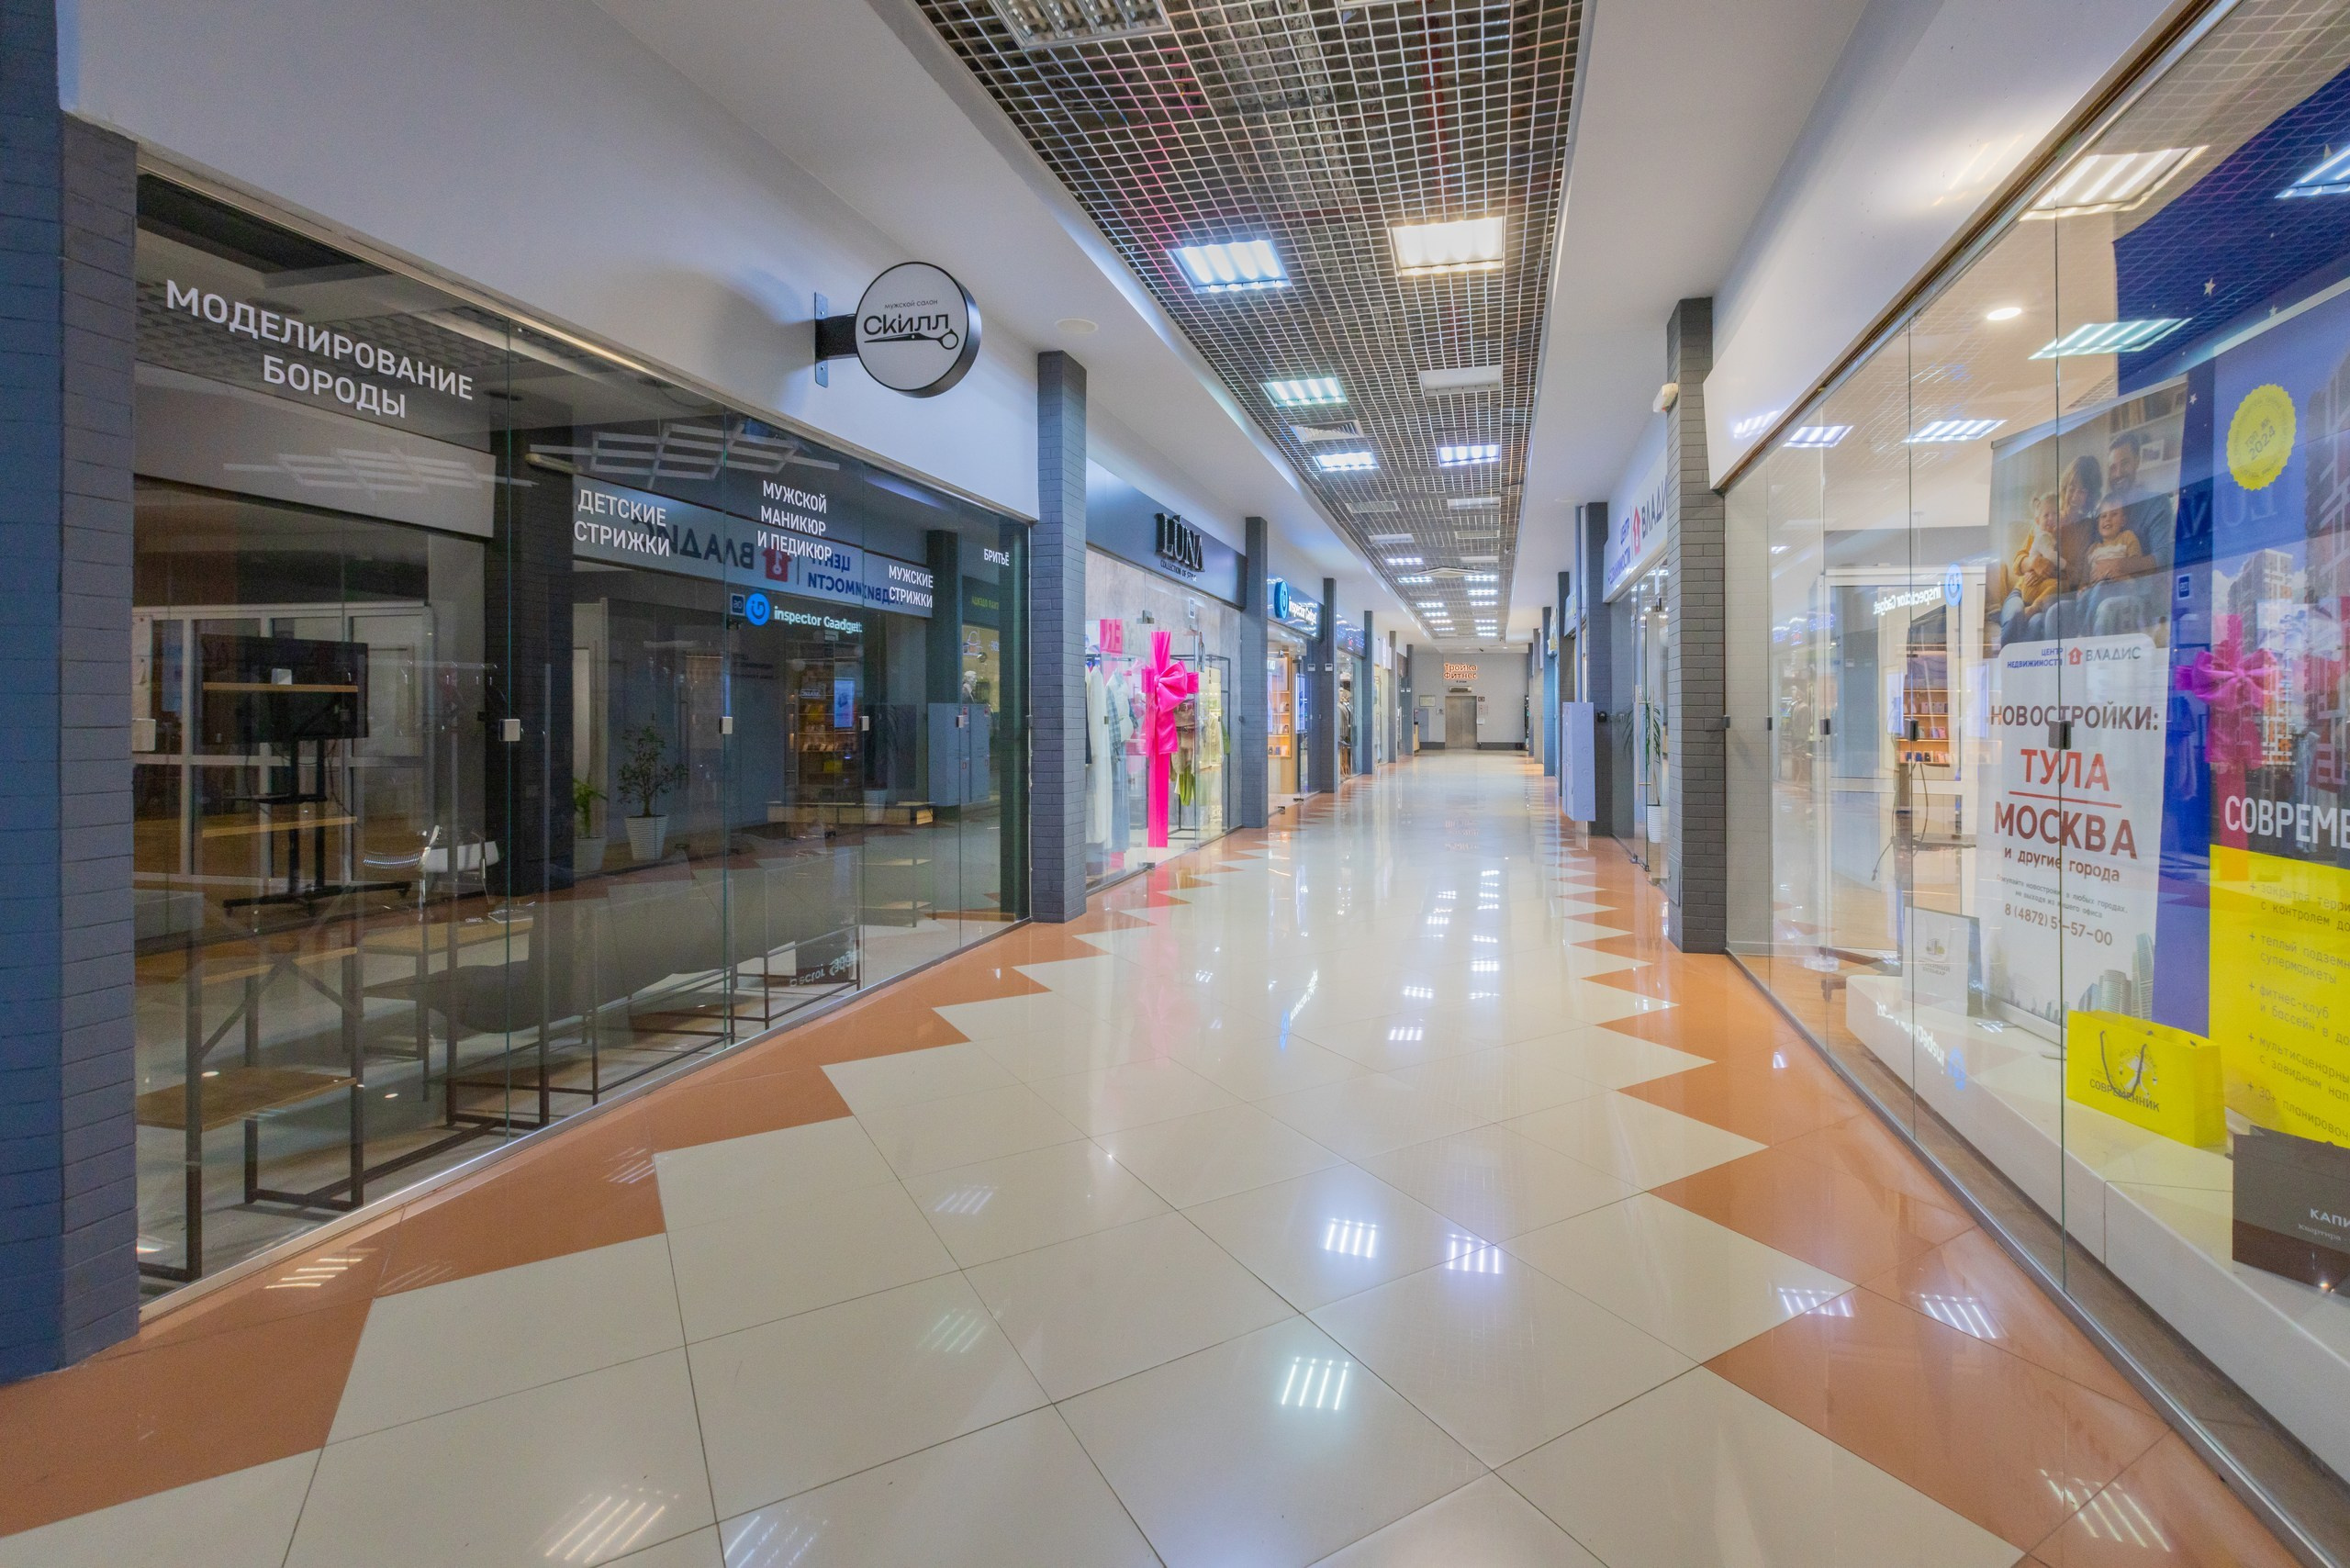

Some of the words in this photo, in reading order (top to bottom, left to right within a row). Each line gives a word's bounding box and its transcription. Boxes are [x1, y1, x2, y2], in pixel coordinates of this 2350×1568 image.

[884, 299, 915, 309] мужской
[917, 298, 938, 308] салон
[166, 279, 474, 400] МОДЕЛИРОВАНИЕ
[263, 354, 407, 419] БОРОДЫ
[2248, 425, 2276, 461] 2024
[577, 488, 666, 527] ДЕТСКИЕ
[762, 479, 827, 514] МУЖСКОЙ
[760, 505, 826, 536] МАНИКЮР
[574, 520, 670, 557] СТРИЖКИ
[757, 530, 767, 548] И
[770, 532, 833, 562] ПЕДИКЮР
[983, 548, 1010, 566] БРИТЬЁ
[889, 564, 934, 588] МУЖСКИЕ
[889, 586, 934, 609] СТРИЖКИ
[774, 605, 822, 627] inspector
[2085, 646, 2142, 662] ВЛАДИС
[1443, 671, 1478, 680] Фитнес
[1990, 700, 2159, 731] НОВОСТРОЙКИ:
[2020, 748, 2110, 792] ТУЛА
[1994, 801, 2138, 860] МОСКВА
[2225, 795, 2350, 849] СОВРЕМЕ
[2004, 846, 2012, 859] и
[2018, 849, 2062, 869] другие
[2069, 859, 2121, 882] города
[2004, 902, 2012, 916] 8
[2014, 904, 2048, 927] (4872)
[2272, 904, 2331, 927] контролем
[2260, 935, 2297, 954] теплый
[2260, 952, 2337, 985] супермаркеты
[2259, 983, 2330, 1021] фитнес-клуб
[2272, 1005, 2315, 1033] бассейн
[2271, 1059, 2322, 1090] завидным
